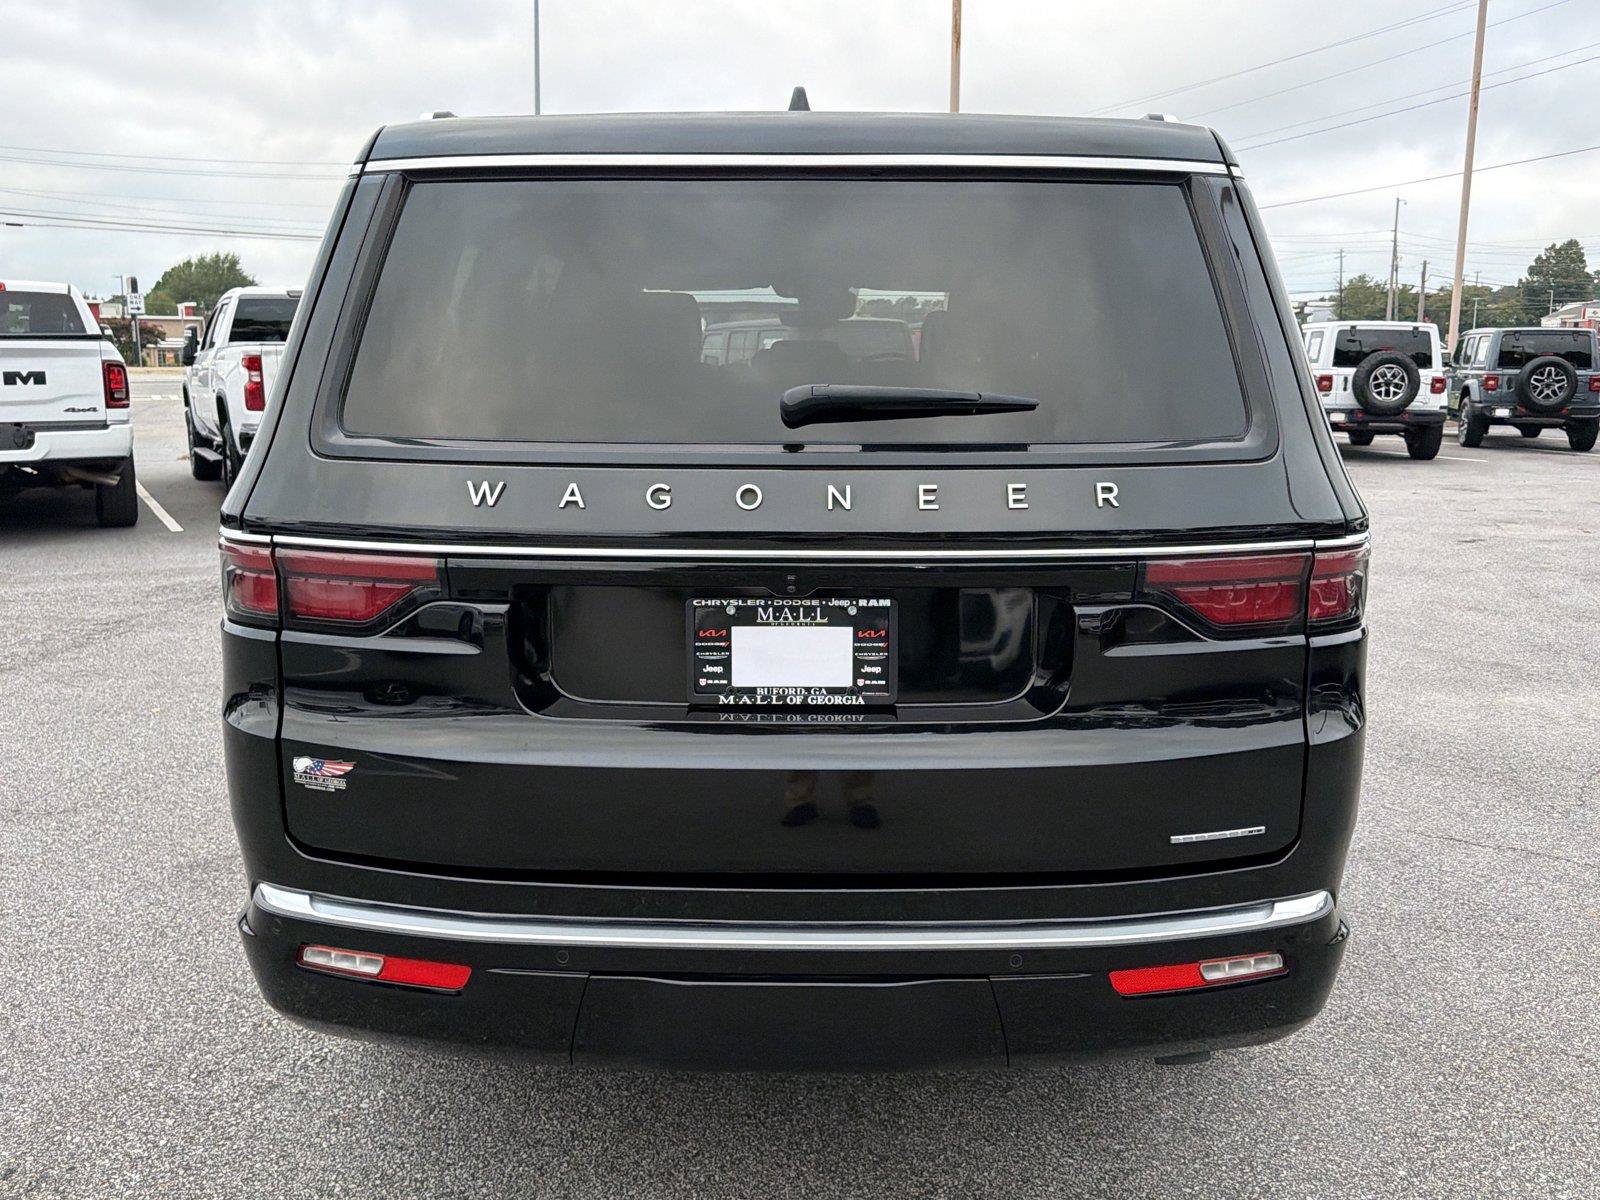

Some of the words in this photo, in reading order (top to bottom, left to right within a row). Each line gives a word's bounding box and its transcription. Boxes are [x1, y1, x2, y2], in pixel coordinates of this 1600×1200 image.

[467, 480, 1120, 510] WAGONEER
[828, 598, 850, 608] Jeep
[858, 599, 891, 607] RAM
[702, 664, 723, 673] Jeep
[861, 665, 882, 674] Jeep
[811, 687, 827, 695] GA
[787, 696, 804, 704] OF
[808, 696, 865, 704] GEORGIA
